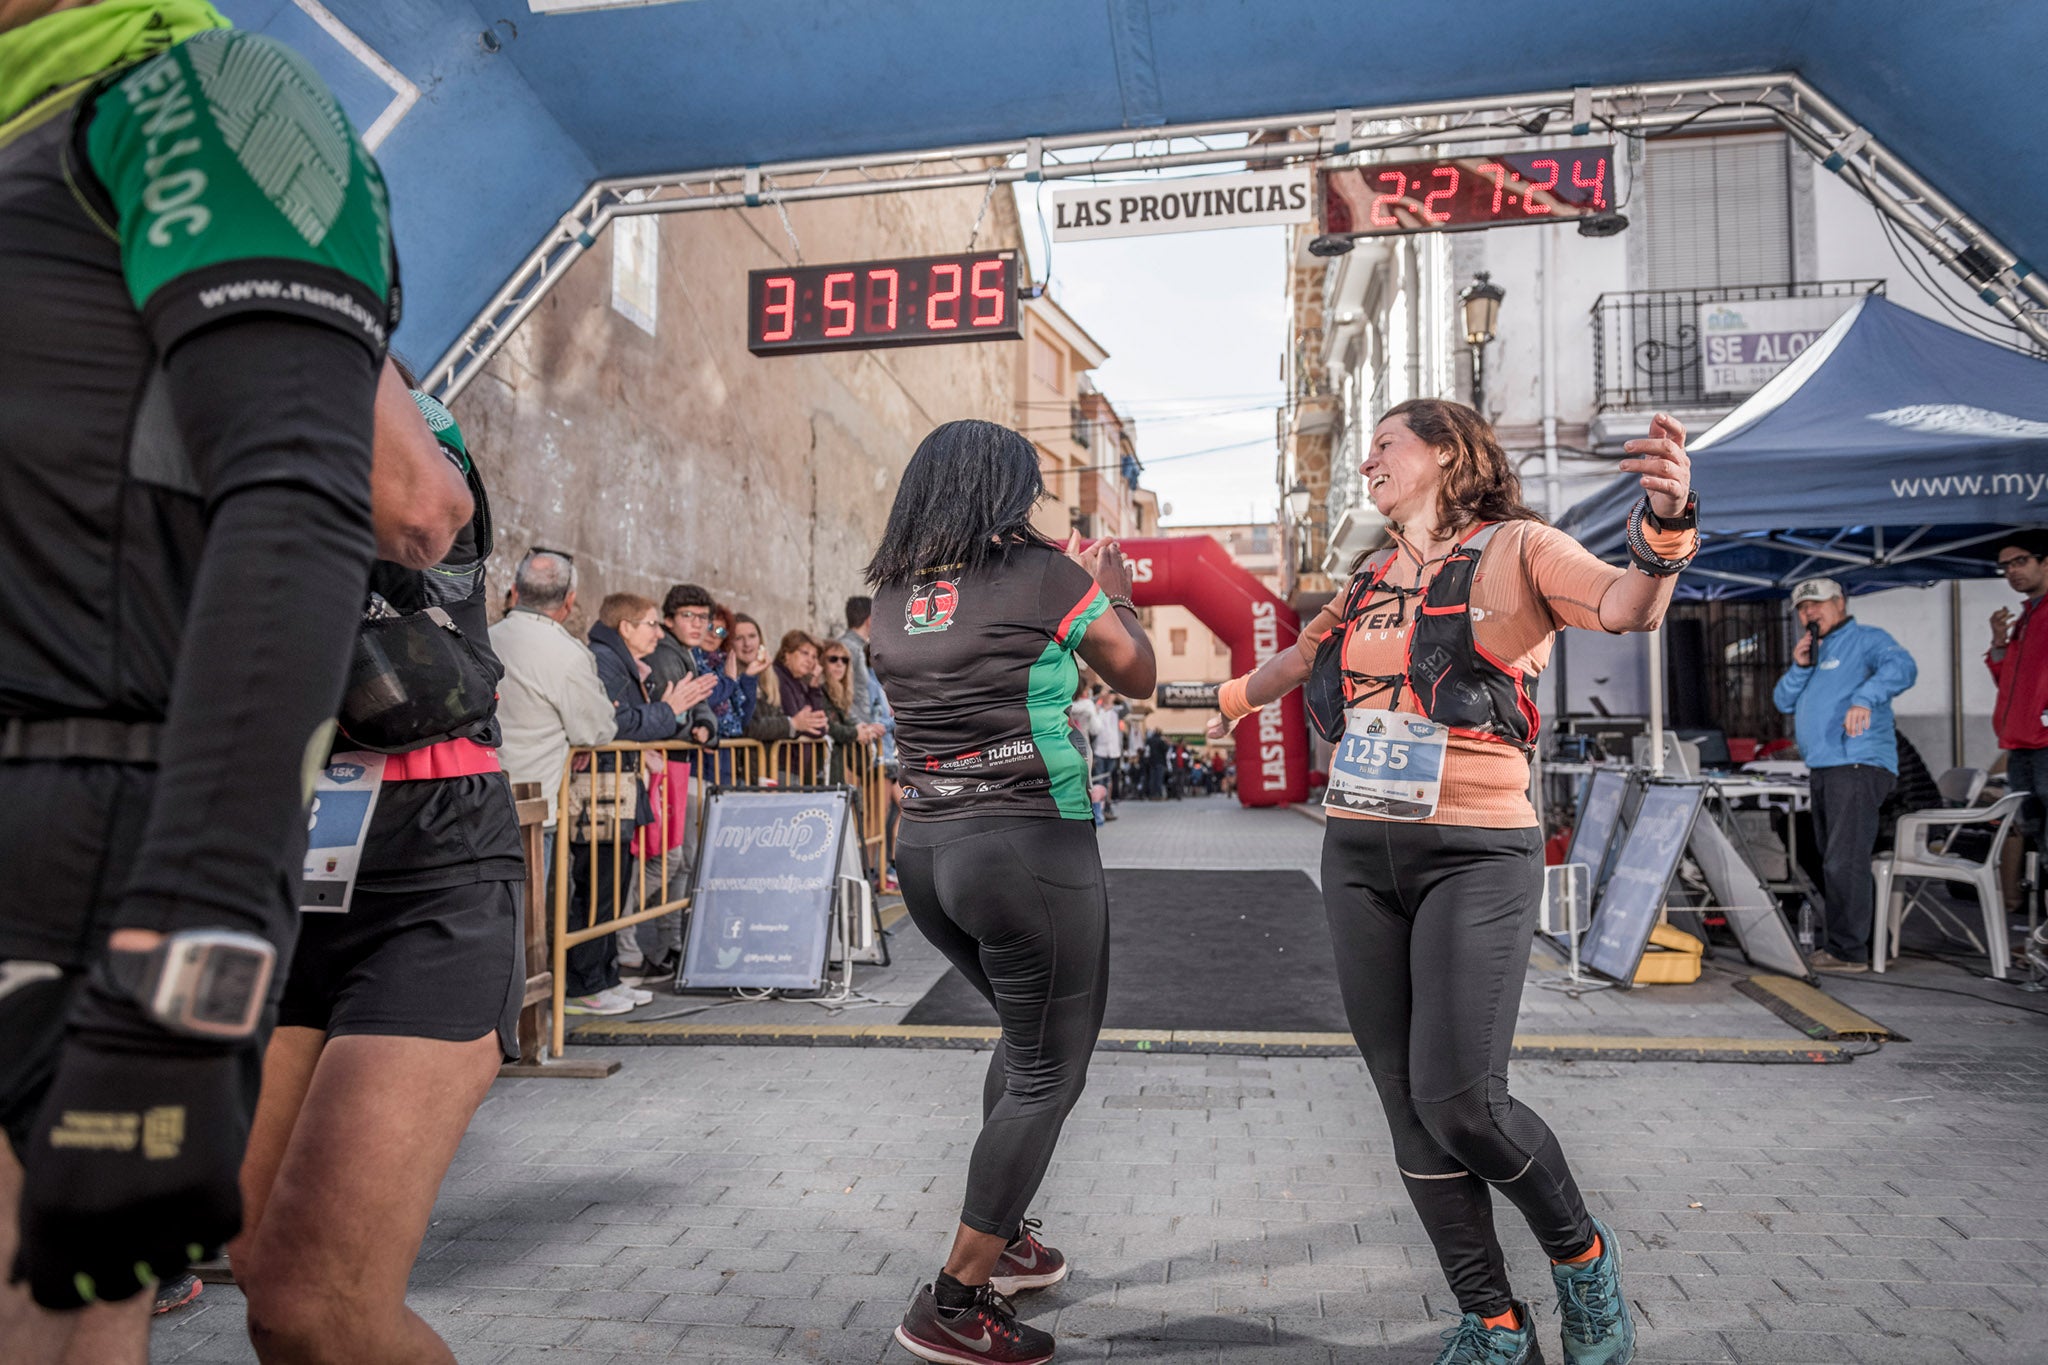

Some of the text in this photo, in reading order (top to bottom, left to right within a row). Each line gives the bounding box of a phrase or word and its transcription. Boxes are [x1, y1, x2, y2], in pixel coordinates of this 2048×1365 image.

[1056, 182, 1307, 230] LAS PROVINCIAS
[1710, 336, 1743, 364] SE
[1890, 473, 2048, 502] www.my
[988, 740, 1034, 761] nutrilia
[1343, 737, 1410, 770] 1255
[1260, 744, 1287, 791] LAS
[715, 817, 813, 855] mychip
